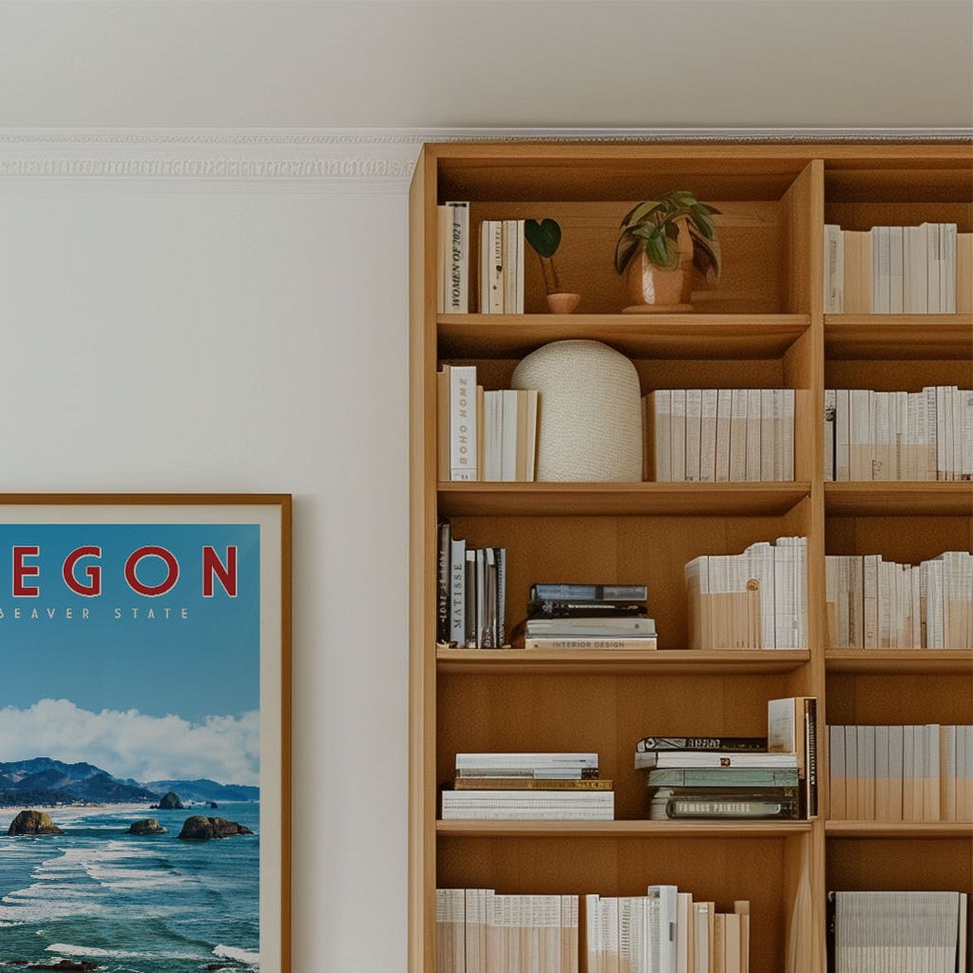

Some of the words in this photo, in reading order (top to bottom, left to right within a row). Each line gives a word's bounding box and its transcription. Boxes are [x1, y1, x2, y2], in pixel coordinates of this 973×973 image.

[451, 245, 461, 262] OF
[451, 264, 461, 307] WOMEN
[459, 378, 468, 418] HOME
[458, 424, 468, 465] BOHO
[114, 607, 189, 619] STATE
[453, 562, 463, 629] MATISSE
[678, 803, 710, 813] FAMOUS
